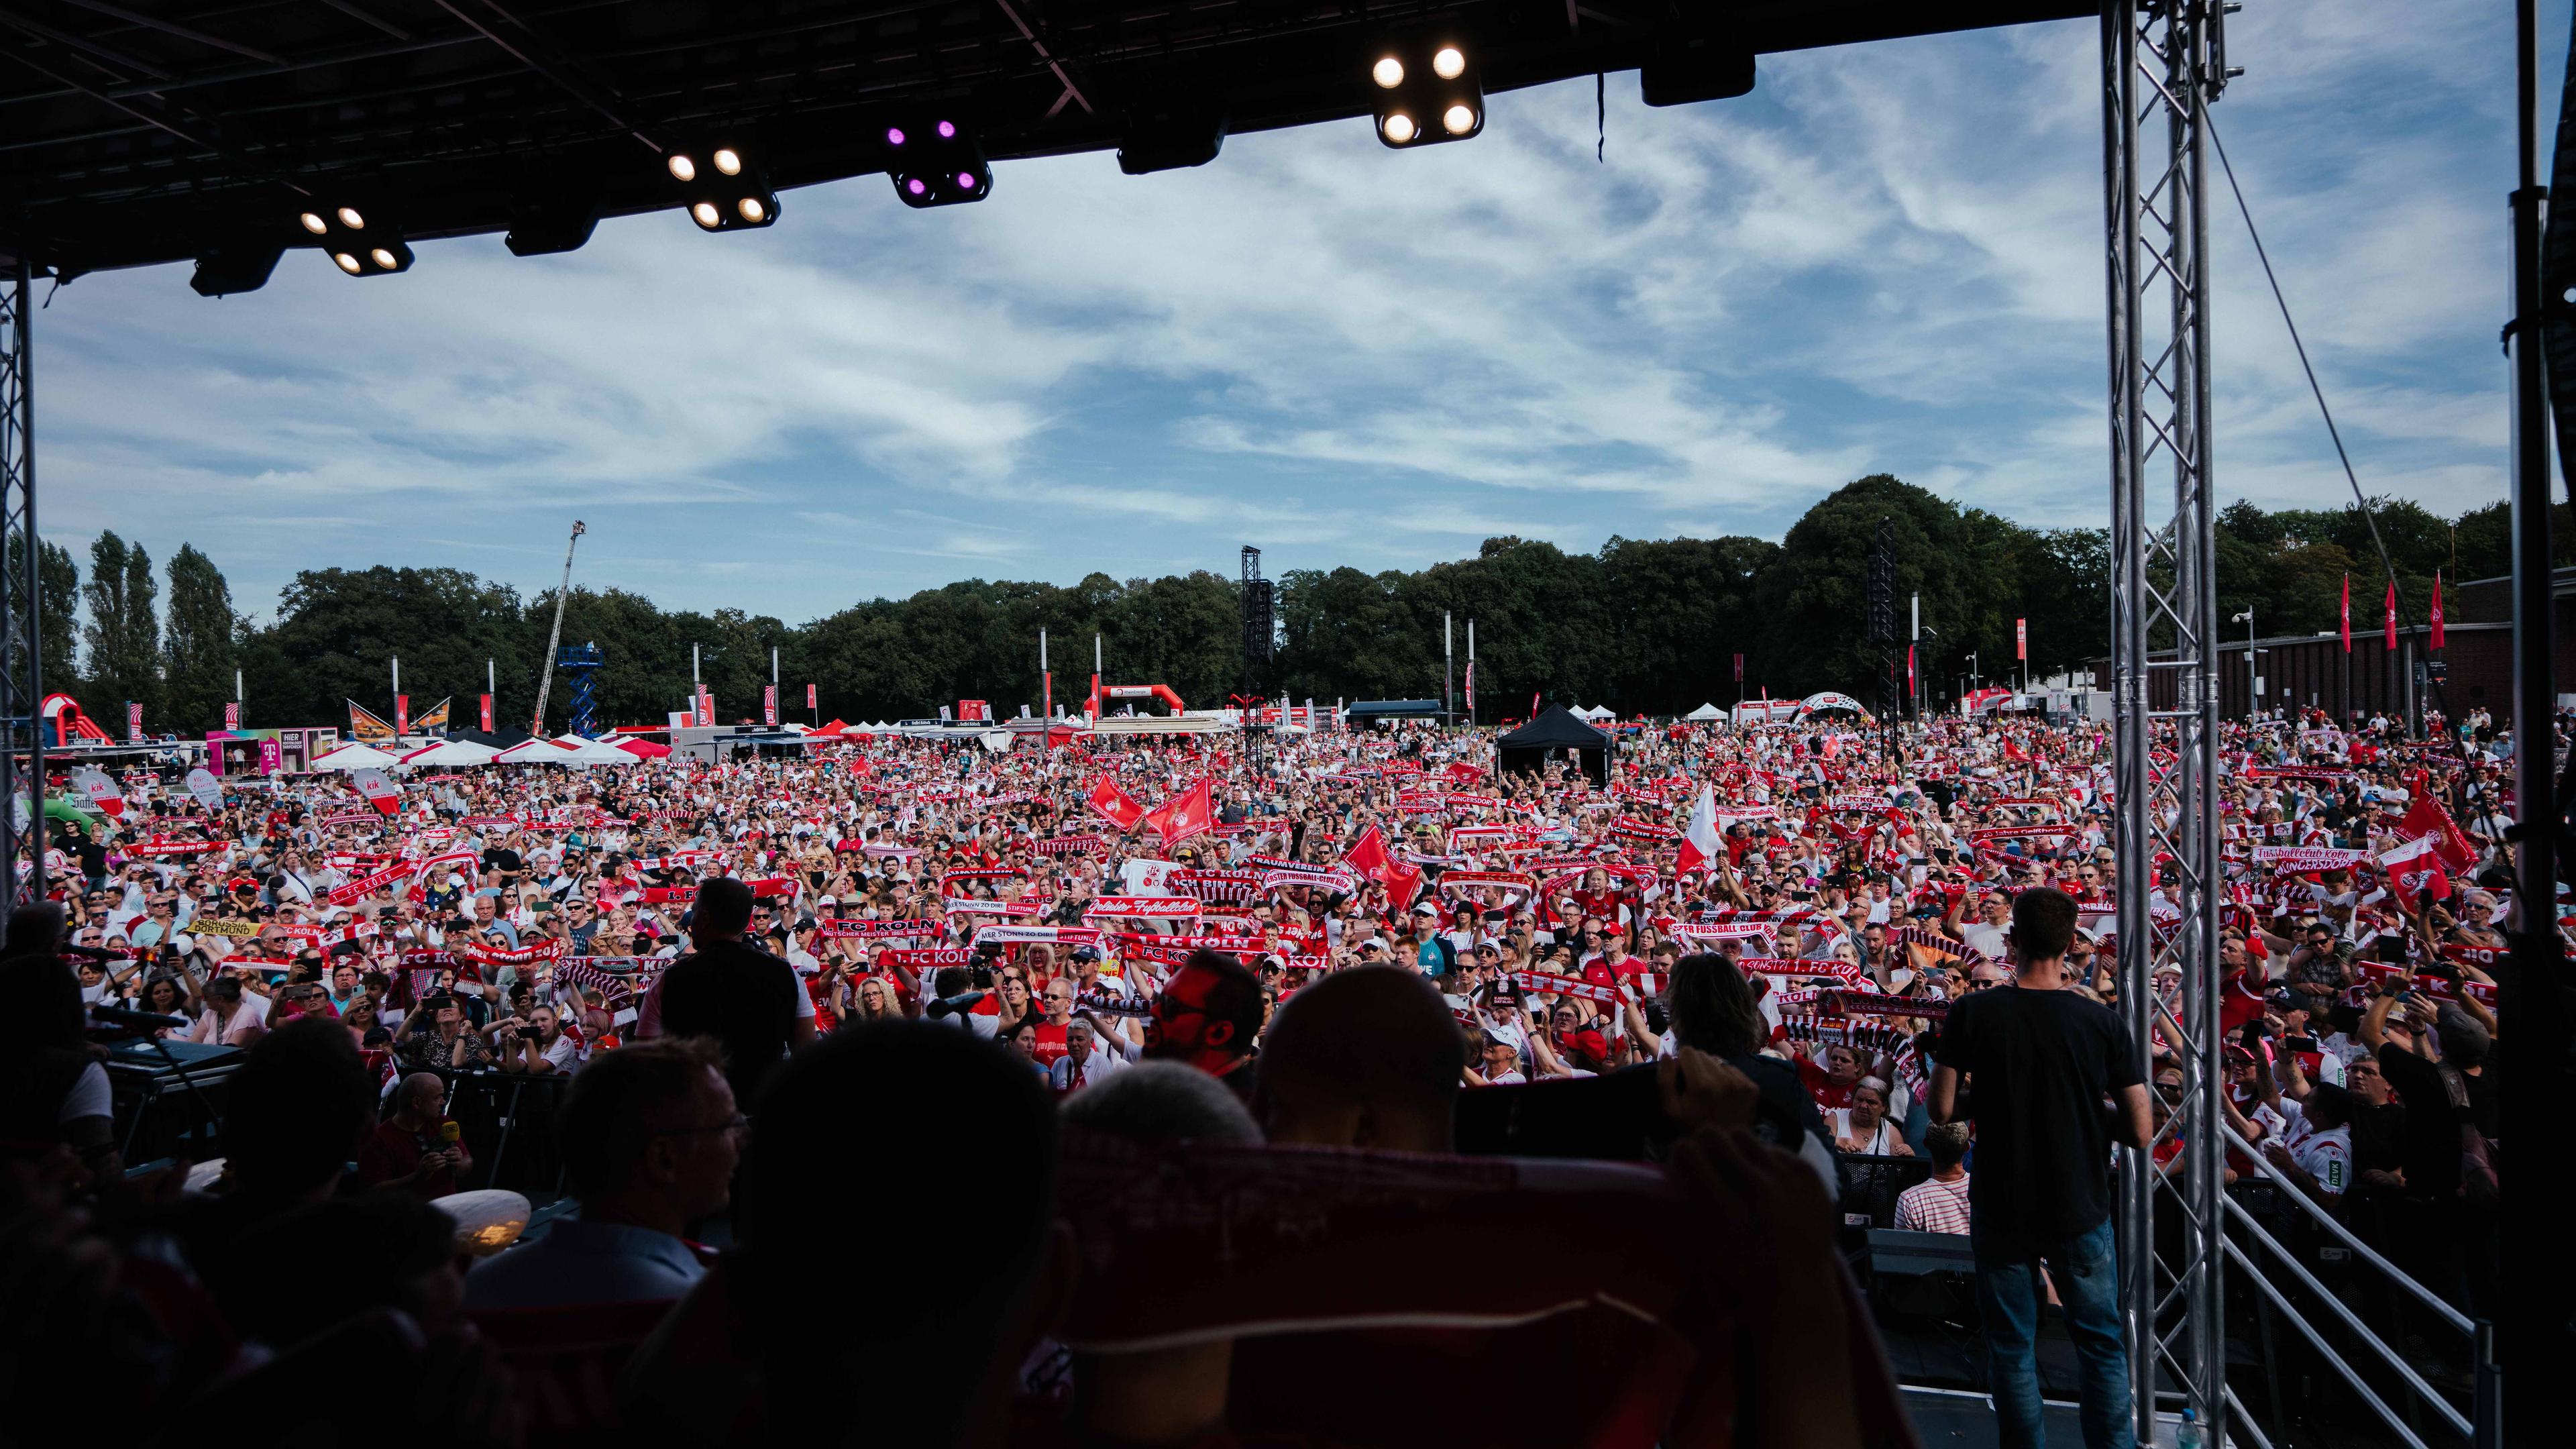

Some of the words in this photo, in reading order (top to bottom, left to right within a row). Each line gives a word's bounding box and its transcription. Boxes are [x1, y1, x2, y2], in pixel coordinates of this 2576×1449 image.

[91, 782, 104, 793] kik
[367, 780, 379, 790] kik
[1640, 790, 1659, 799] KÖLN
[1449, 795, 1493, 805] MÜNGERSDORF
[1635, 822, 1653, 830] STONN
[2021, 827, 2065, 835] Geißbock
[143, 844, 160, 853] Mer
[1560, 855, 1597, 864] KÖLN
[1252, 857, 1326, 873] TRAUMVEREIN
[1179, 870, 1191, 878] 1.
[1195, 869, 1218, 877] FC
[1220, 869, 1266, 881] KÖLN
[1267, 872, 1287, 883] ERSTER
[1288, 872, 1334, 884] FUSSBALL-CLUB
[347, 885, 360, 896] FC
[365, 873, 392, 889] KÖLN
[1203, 879, 1227, 888] BIN
[1232, 880, 1251, 888] FC
[668, 891, 681, 900] 1.
[1008, 904, 1036, 913] STIFTUNG
[1087, 899, 1132, 915] Geliebter
[198, 919, 248, 928] BORUSSIA
[837, 922, 867, 931] FC
[875, 919, 935, 930] KÖLN
[195, 925, 250, 934] DORTMUND
[294, 926, 321, 936] KÖLN
[1059, 934, 1095, 942] STIFTUNG
[1138, 936, 1154, 945] 1.
[1160, 936, 1183, 946] FC
[1190, 936, 1249, 948] KÖLN
[492, 951, 533, 963] stonn
[535, 946, 551, 956] zo
[1126, 944, 1138, 955] 1.
[1142, 946, 1163, 959] FC
[910, 952, 930, 964] FC
[1794, 960, 1805, 972] 1.
[1809, 961, 1827, 973] FC
[1871, 994, 1904, 1006] FC
[2331, 1161, 2339, 1185] DEVK
